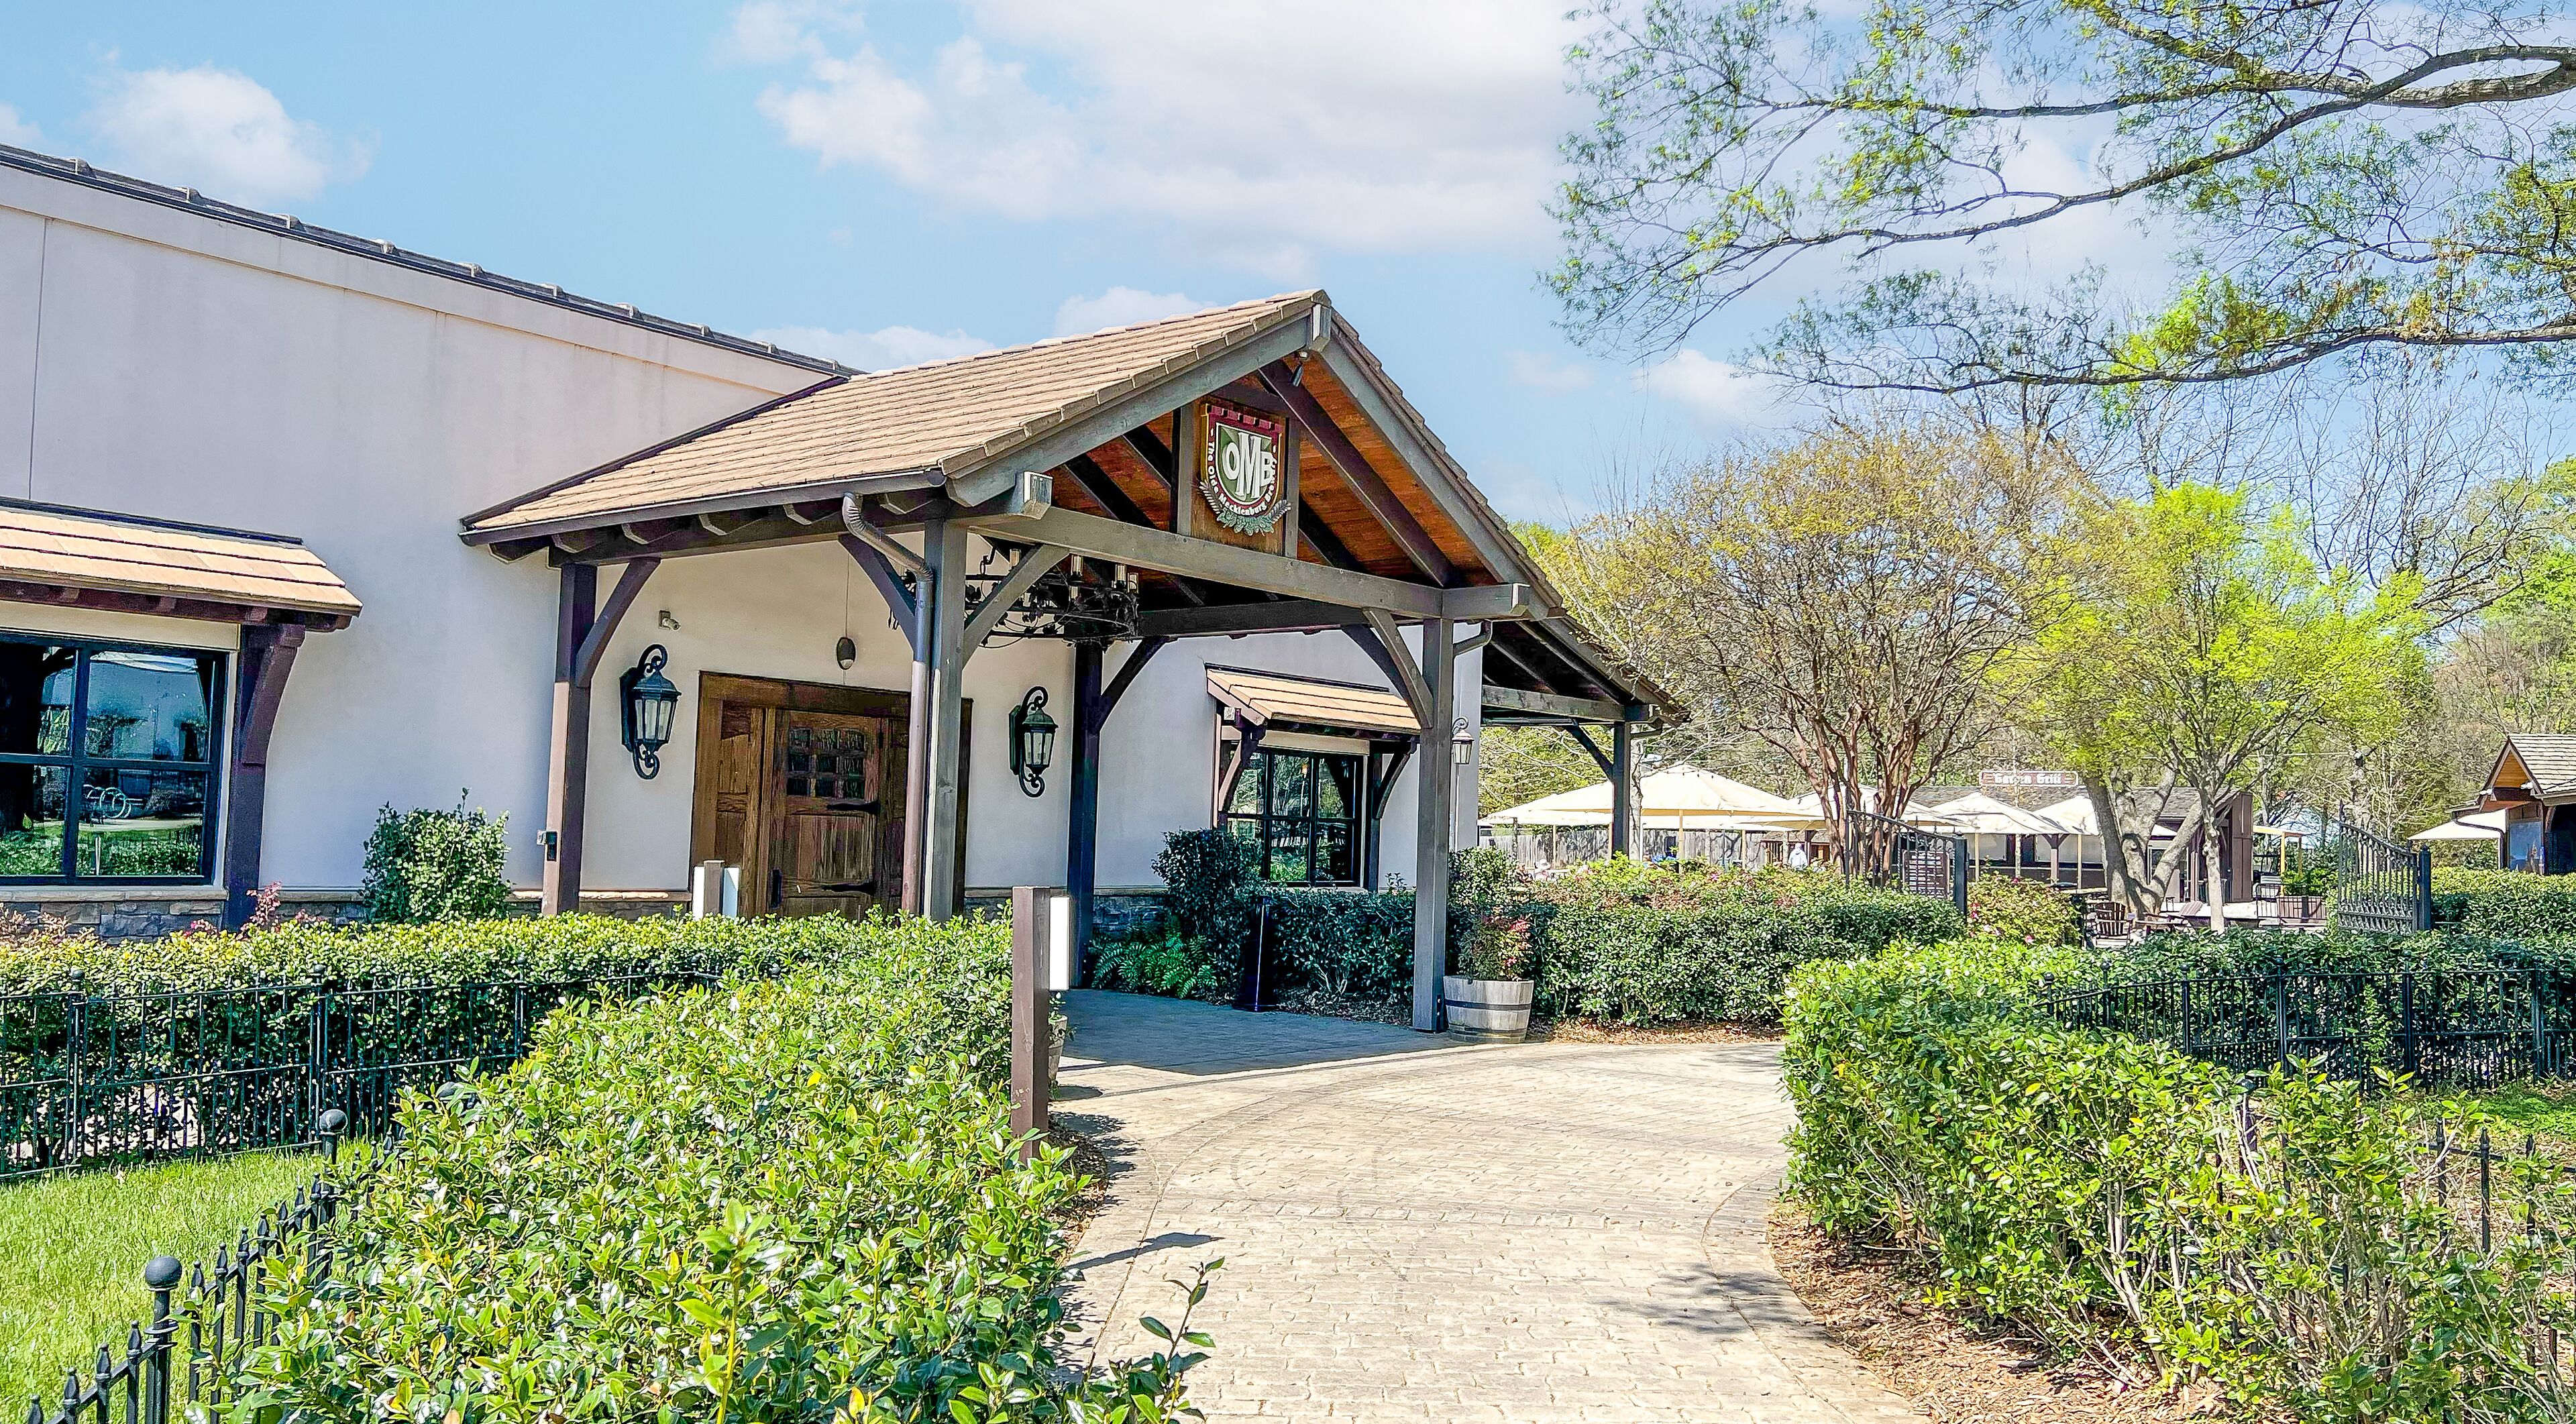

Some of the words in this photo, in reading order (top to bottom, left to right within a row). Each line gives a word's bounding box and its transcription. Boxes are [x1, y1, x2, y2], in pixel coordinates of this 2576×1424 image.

[1208, 465, 1220, 493] Olde
[1218, 493, 1267, 515] Mecklenburg
[1222, 432, 1273, 500] OMB
[2037, 773, 2061, 784] Grill
